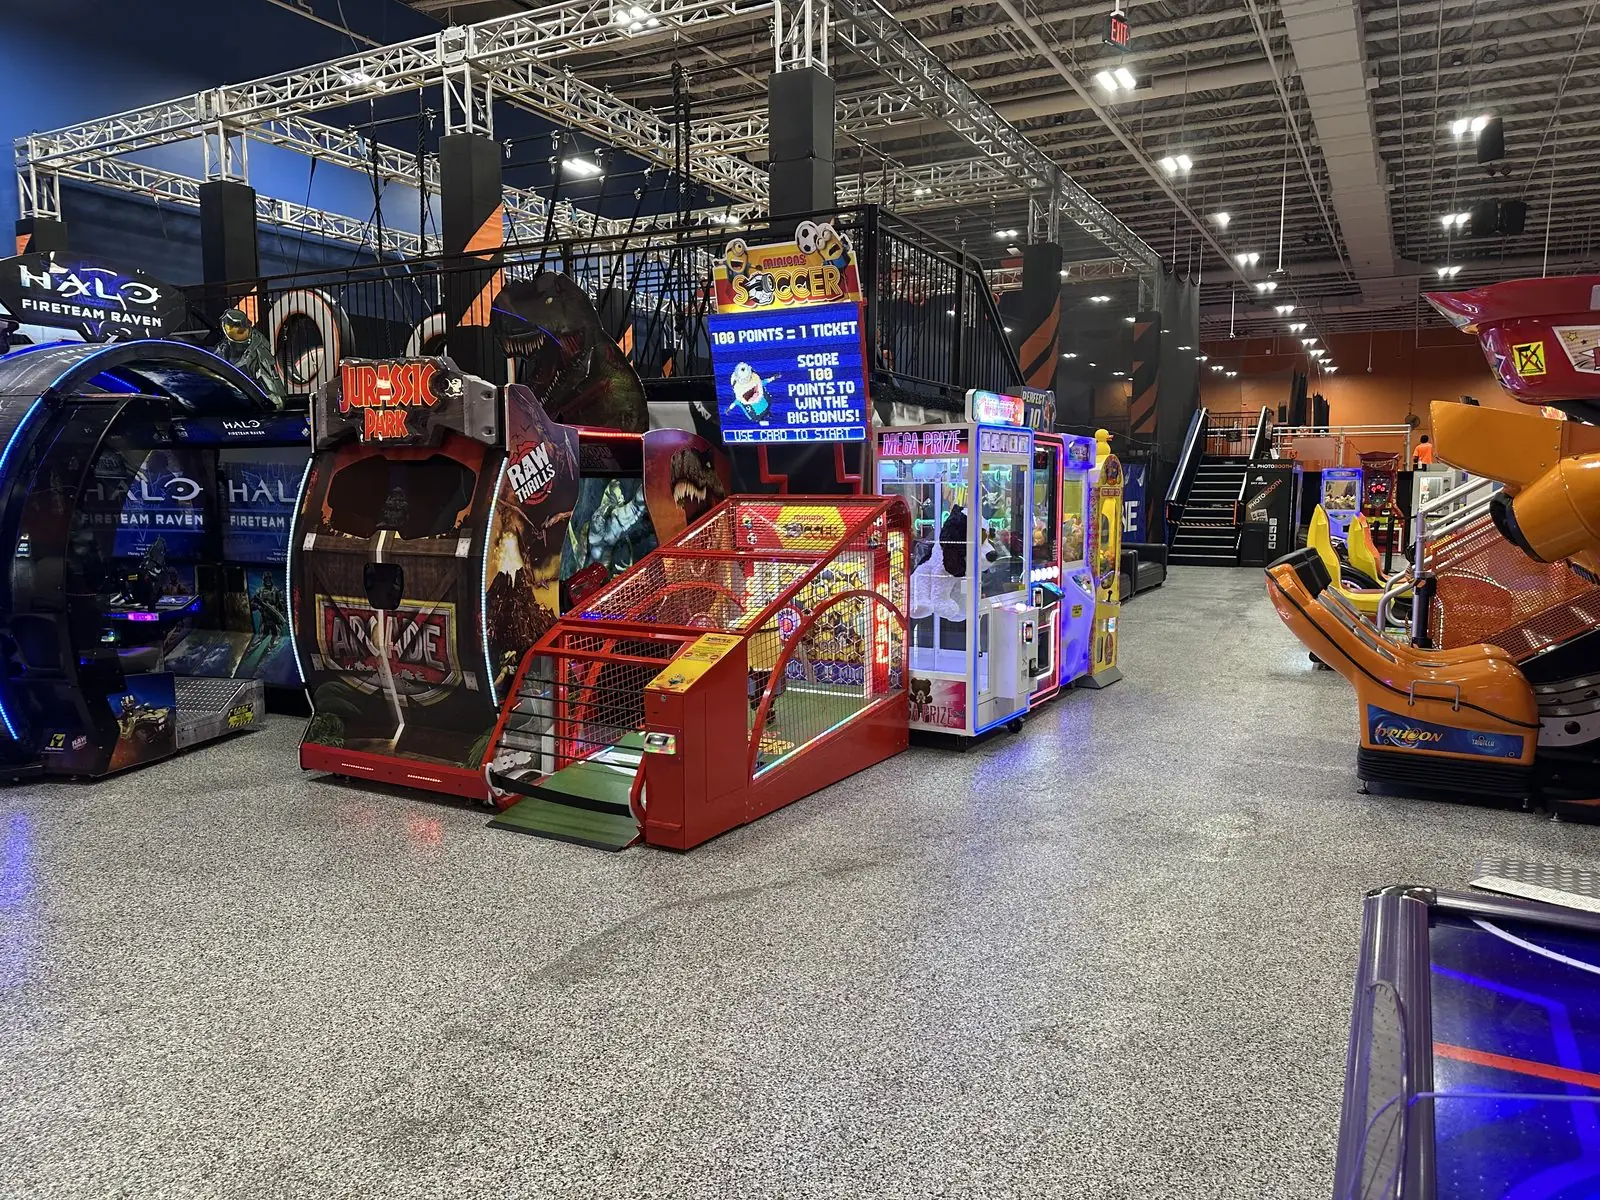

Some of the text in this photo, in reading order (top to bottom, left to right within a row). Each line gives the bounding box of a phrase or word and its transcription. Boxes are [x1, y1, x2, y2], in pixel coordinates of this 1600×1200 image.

[1111, 18, 1128, 46] EXIT
[19, 264, 162, 304] HALO
[22, 299, 162, 328] FIRETEAM RAVEN
[712, 331, 735, 345] 100
[738, 327, 784, 343] POINTS
[799, 325, 807, 339] 1
[811, 321, 858, 336] TICKET
[797, 352, 839, 368] SCORE
[808, 368, 833, 381] 100
[340, 363, 438, 413] JURASSIC
[788, 381, 856, 396] POINTS TO
[795, 396, 849, 410] WIN THE
[223, 420, 260, 428] HALO
[364, 408, 409, 441] PARK
[787, 409, 860, 424] BIG BONUS!
[734, 429, 850, 440] USE CARD TO START
[882, 429, 961, 457] MEGA PRIZE
[506, 442, 551, 491] RAW
[228, 479, 301, 502] HAL
[515, 464, 556, 504] THRILLS
[1248, 478, 1283, 509] PHOTOBOOTH
[82, 513, 204, 525] FIRETEAM RAVEN
[230, 515, 285, 528] FIRETEAM
[1375, 726, 1444, 744] TYPHOON
